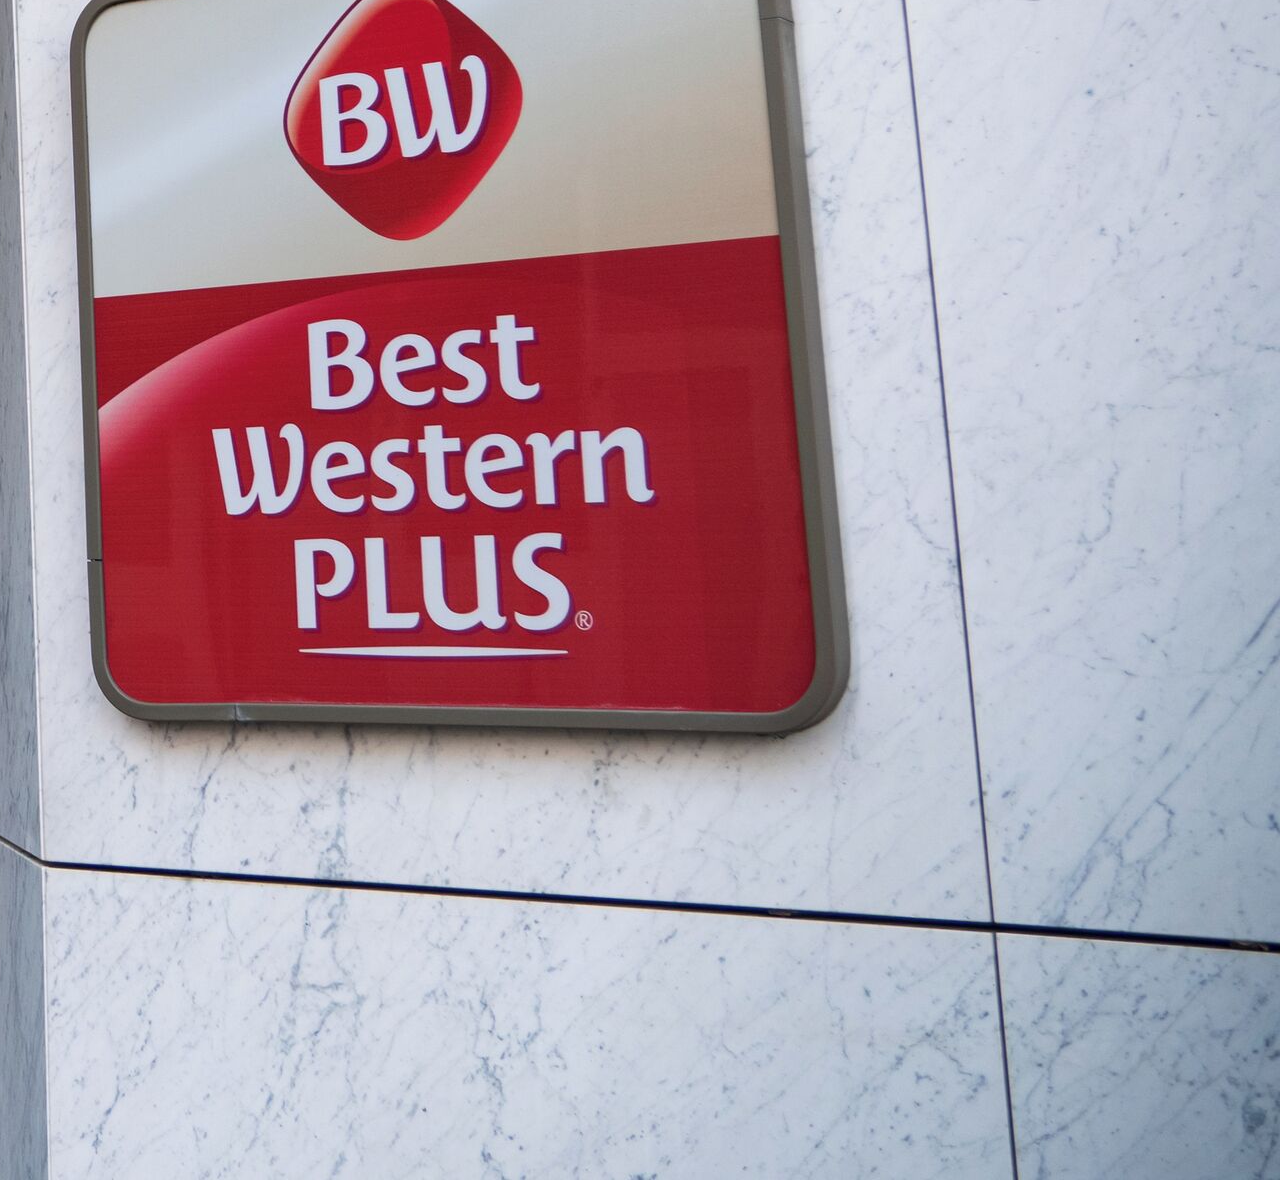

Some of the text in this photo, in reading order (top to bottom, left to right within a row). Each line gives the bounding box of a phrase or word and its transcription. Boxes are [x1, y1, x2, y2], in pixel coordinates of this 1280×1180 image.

[319, 55, 488, 167] BW
[307, 314, 540, 412] Best
[212, 423, 655, 516] Western
